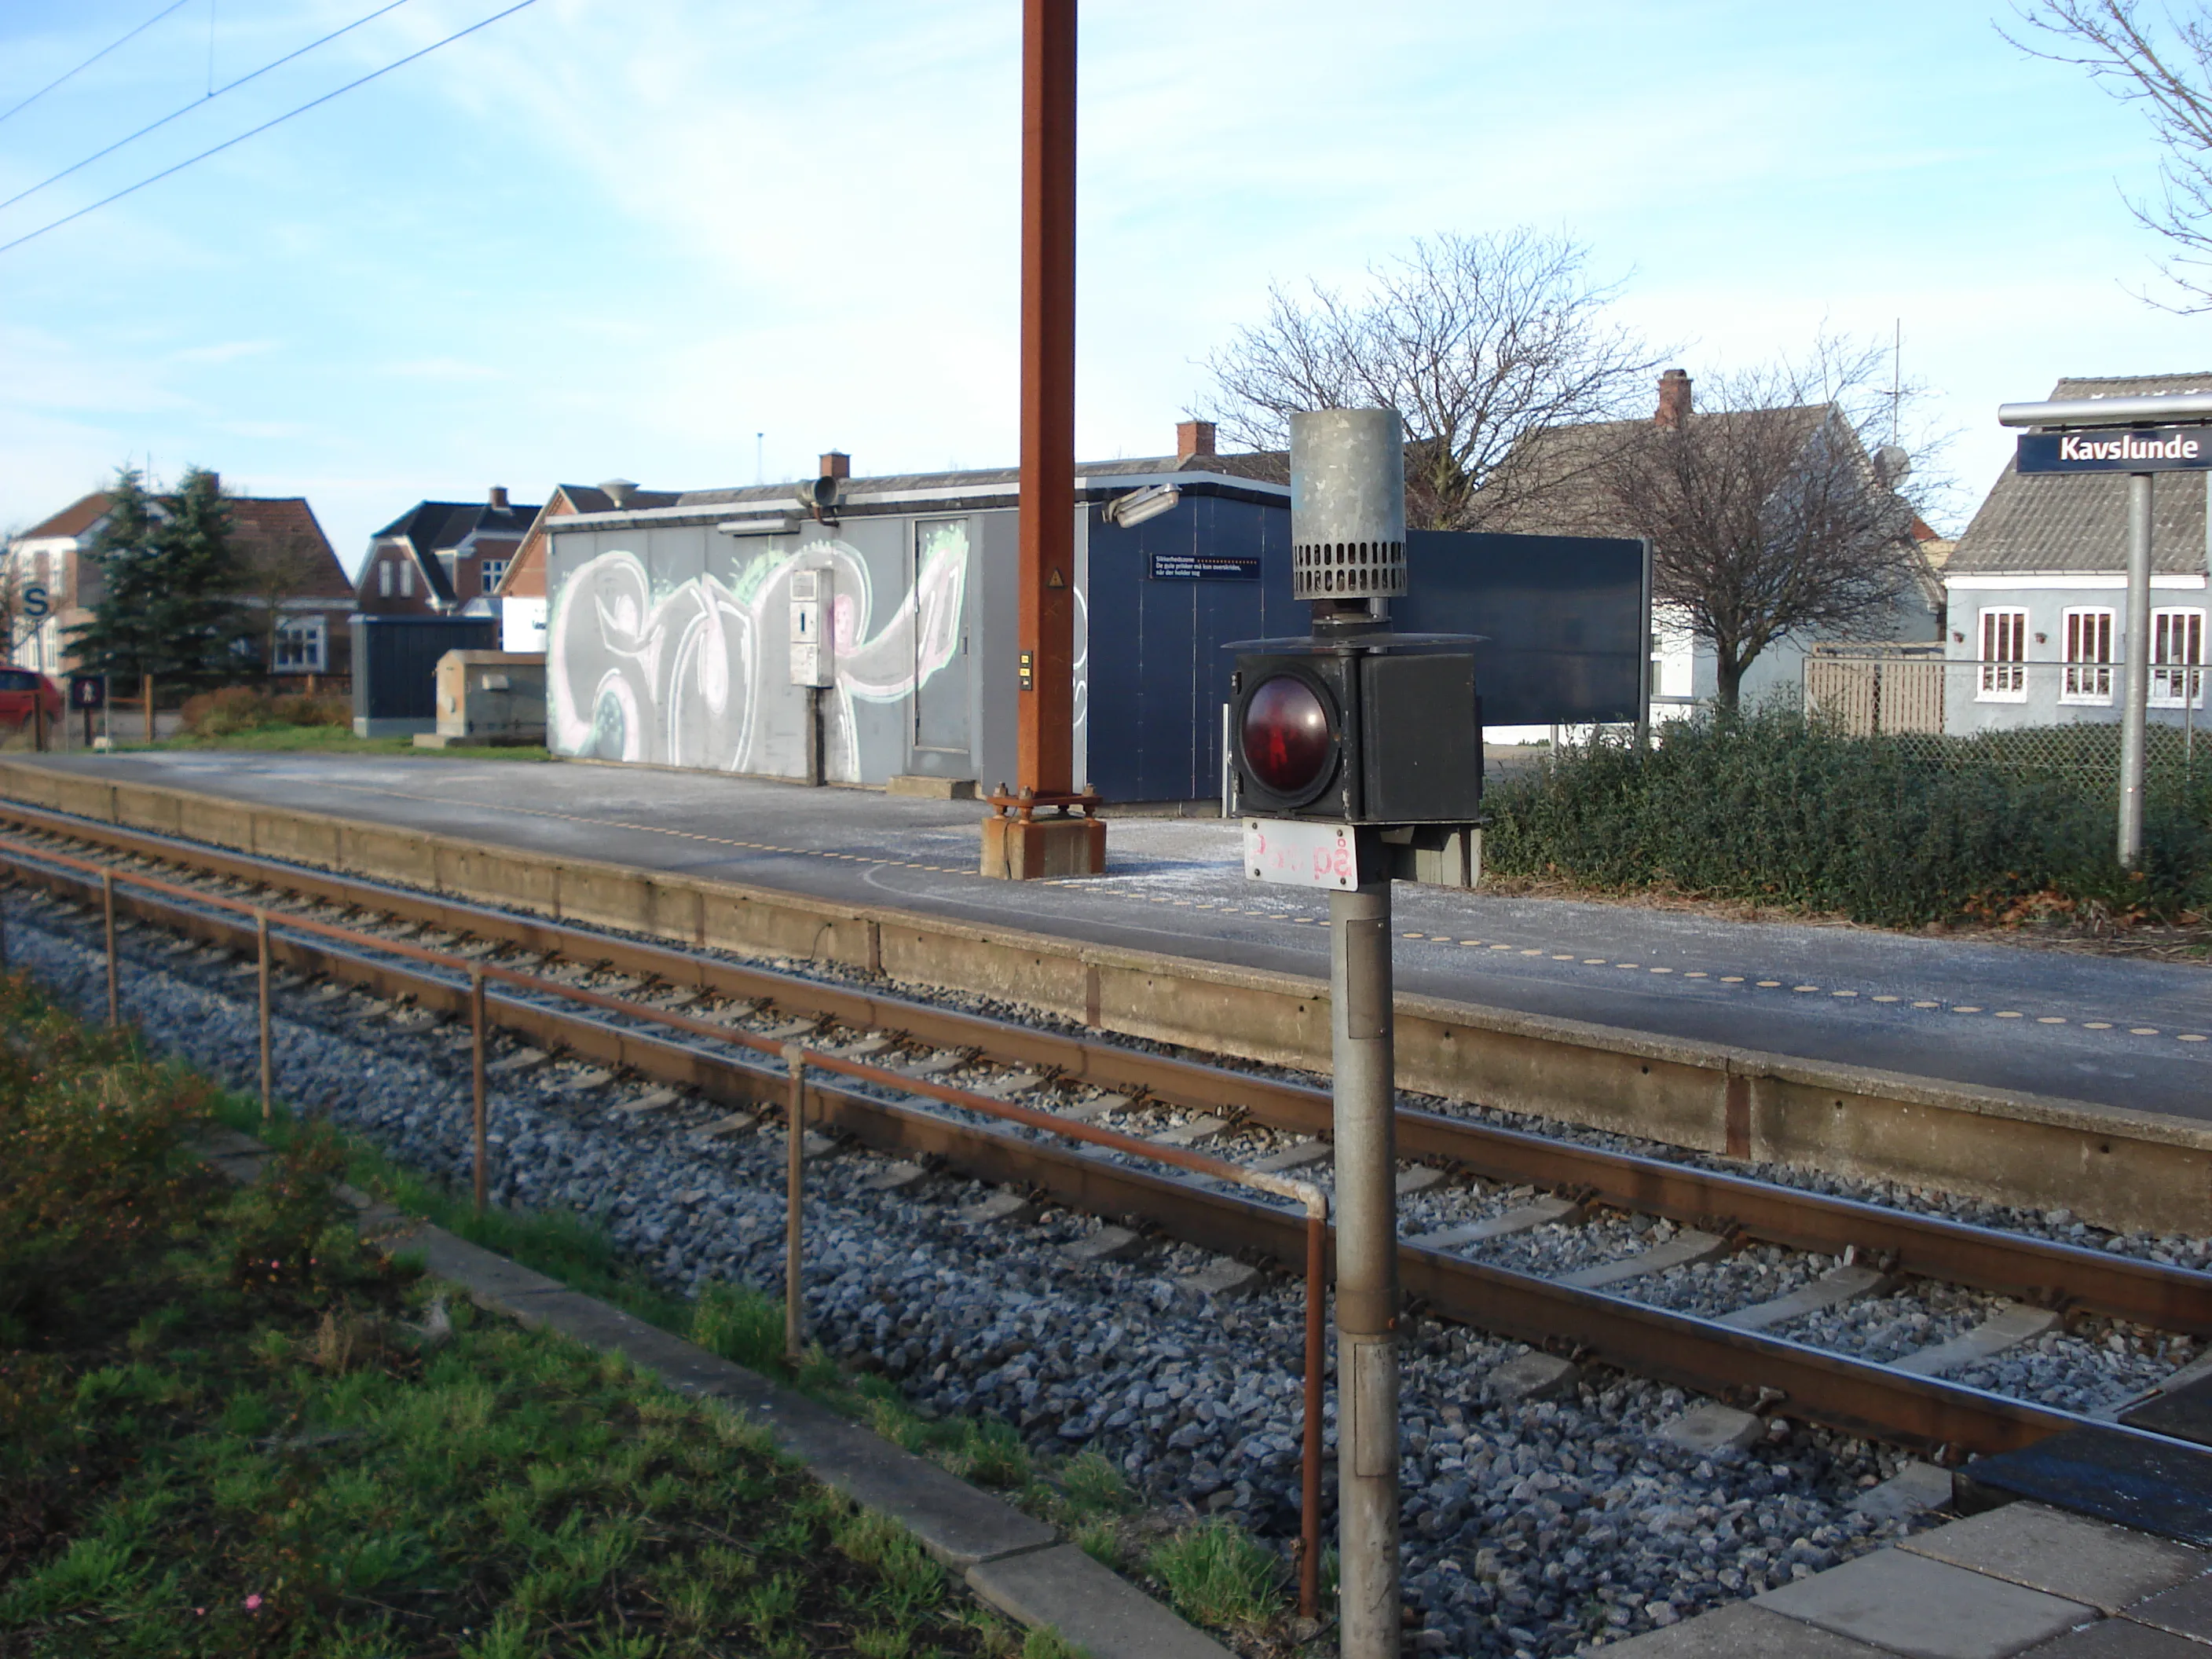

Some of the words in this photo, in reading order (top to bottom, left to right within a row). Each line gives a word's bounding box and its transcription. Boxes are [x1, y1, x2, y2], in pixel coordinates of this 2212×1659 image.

[2060, 434, 2199, 460] Kavslunde
[24, 587, 49, 617] S
[1313, 838, 1353, 881] på
